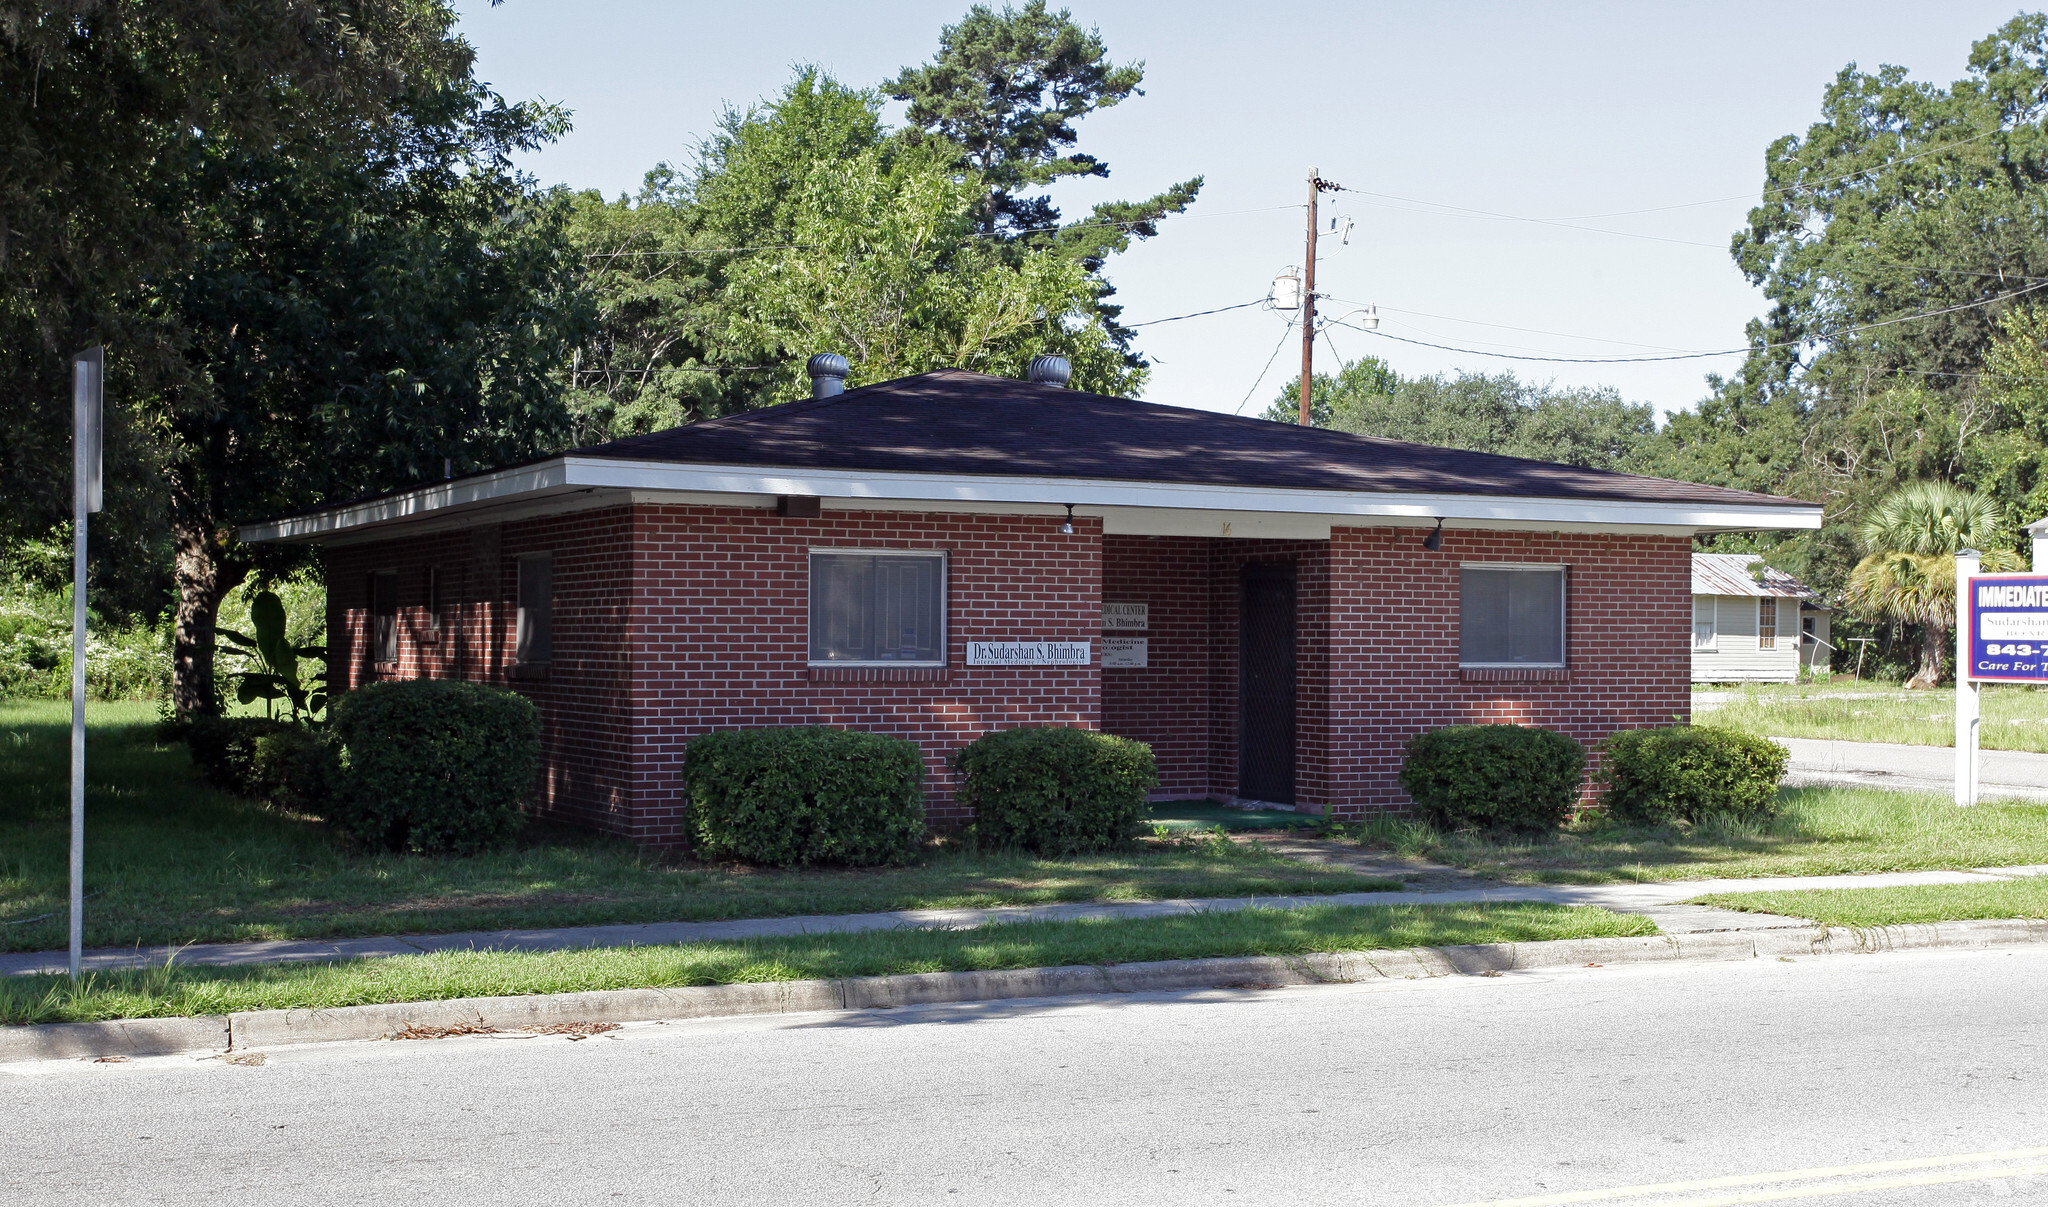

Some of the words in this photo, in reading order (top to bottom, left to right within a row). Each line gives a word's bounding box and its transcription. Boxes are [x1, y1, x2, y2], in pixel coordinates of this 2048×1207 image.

[1978, 586, 2048, 607] IMMEDIATE
[1122, 604, 1146, 616] CENTER
[1116, 617, 1145, 627] Bhimbra
[974, 643, 987, 660] Dr.
[988, 643, 1034, 660] Sudarshan
[1036, 643, 1044, 660] S.
[1047, 643, 1085, 660] Bhimbra
[1978, 661, 2009, 671] Care
[2013, 662, 2037, 672] For
